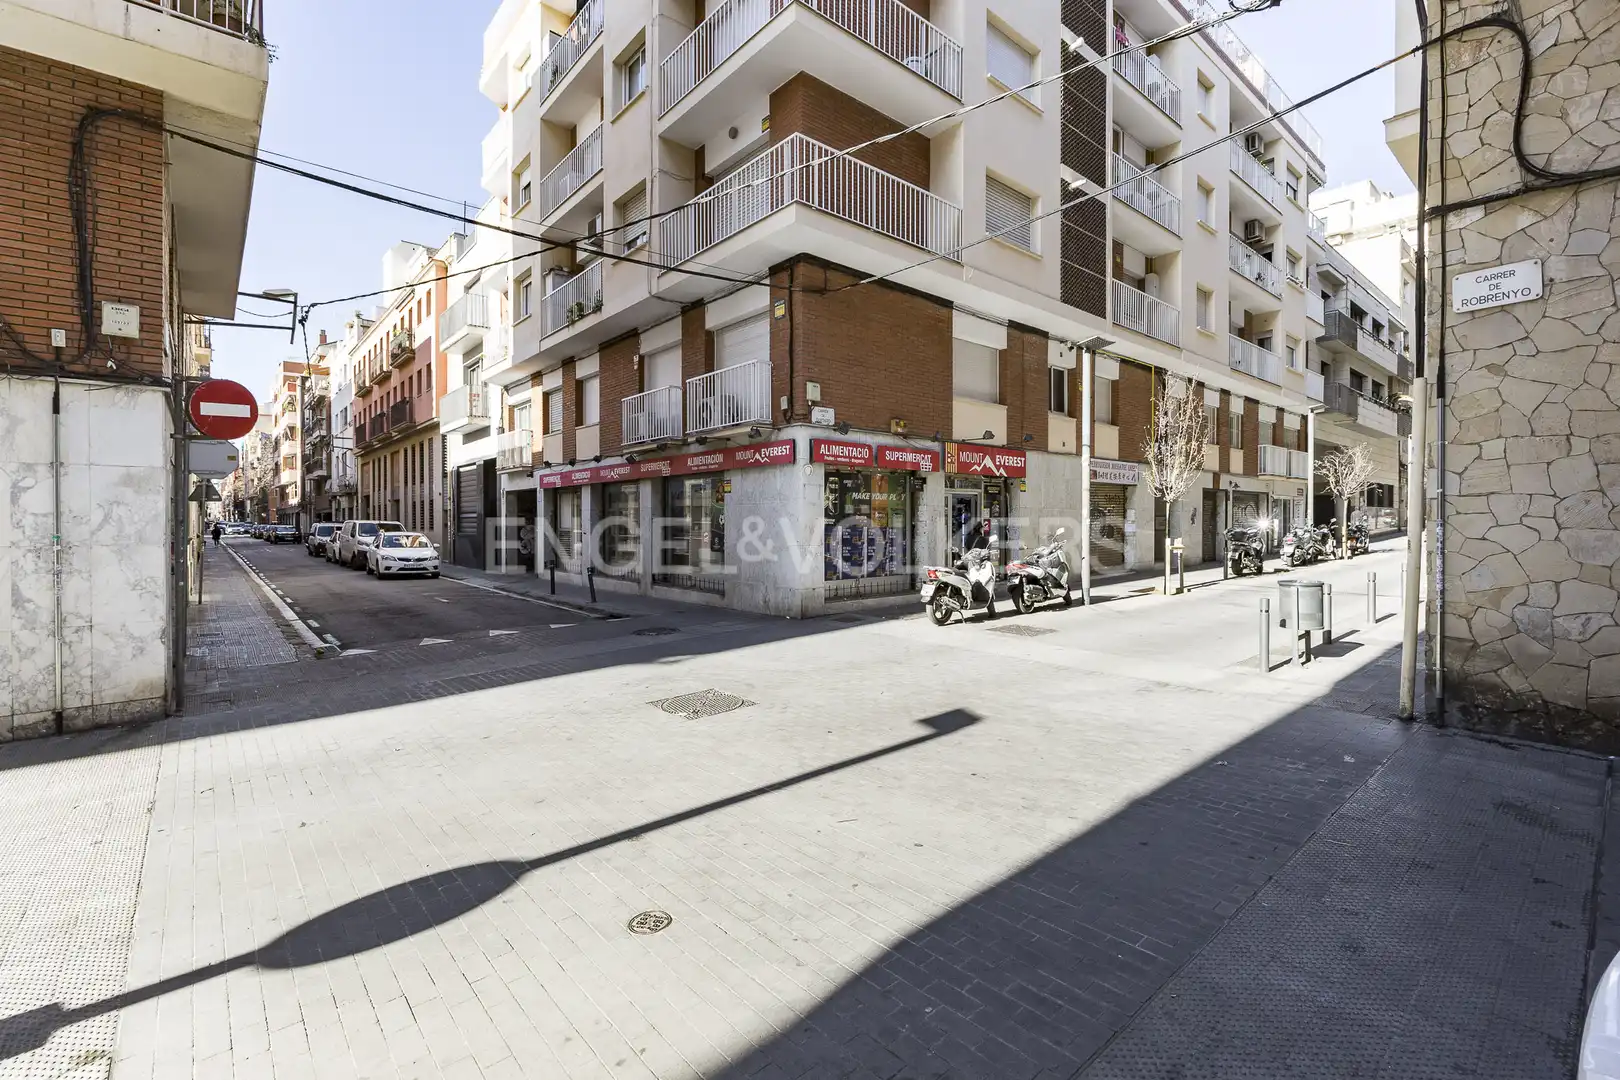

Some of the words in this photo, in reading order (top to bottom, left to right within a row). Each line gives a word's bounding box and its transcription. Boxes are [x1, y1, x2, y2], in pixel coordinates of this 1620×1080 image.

[1475, 269, 1516, 284] CARRER
[1488, 282, 1502, 292] DE
[1461, 287, 1532, 308] ROBRENYO
[735, 449, 755, 461] MOUNT
[761, 445, 791, 458] EVEREST
[819, 444, 869, 459] ALIMENTACIÓ
[885, 450, 932, 464] SUPERMERCAT
[640, 460, 671, 472] SUPERMERCAT
[687, 453, 724, 467] ALIMENTACIÓN
[959, 451, 984, 464] MOUNT
[995, 454, 1025, 468] EVEREST
[851, 492, 871, 500] MAKE
